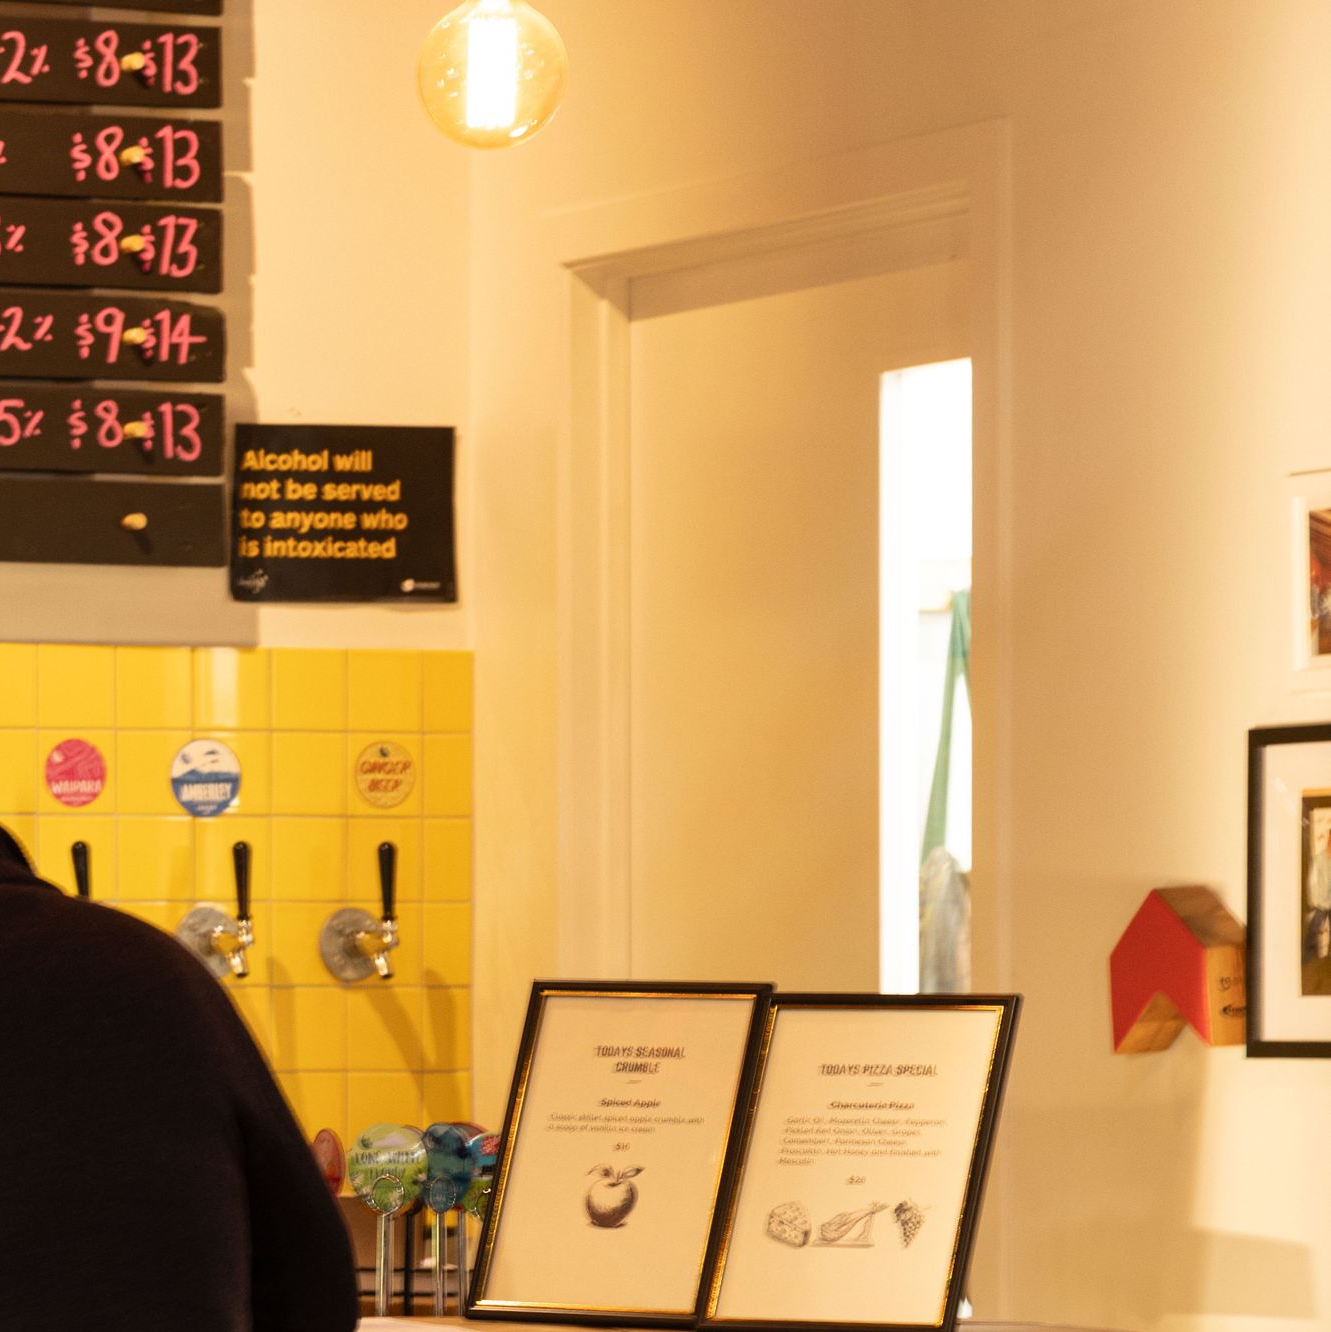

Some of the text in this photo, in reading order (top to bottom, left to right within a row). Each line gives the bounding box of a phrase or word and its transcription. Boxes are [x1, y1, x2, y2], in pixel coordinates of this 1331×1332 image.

[72, 28, 121, 89] $8
[68, 124, 125, 183] $8
[68, 210, 125, 267] $8
[73, 305, 127, 365] $9
[66, 398, 125, 450] $8
[240, 448, 373, 472] Alcohol will
[240, 477, 401, 501] not be served
[239, 507, 409, 534] to anyone who
[238, 536, 397, 559] is intoxicated
[180, 782, 233, 802] AMBERLEY
[595, 1045, 687, 1060] TODAYS SEASONAL
[613, 1061, 661, 1074] CRUMBLE
[819, 1063, 938, 1077] TODAYS PIZZA SPECIAL
